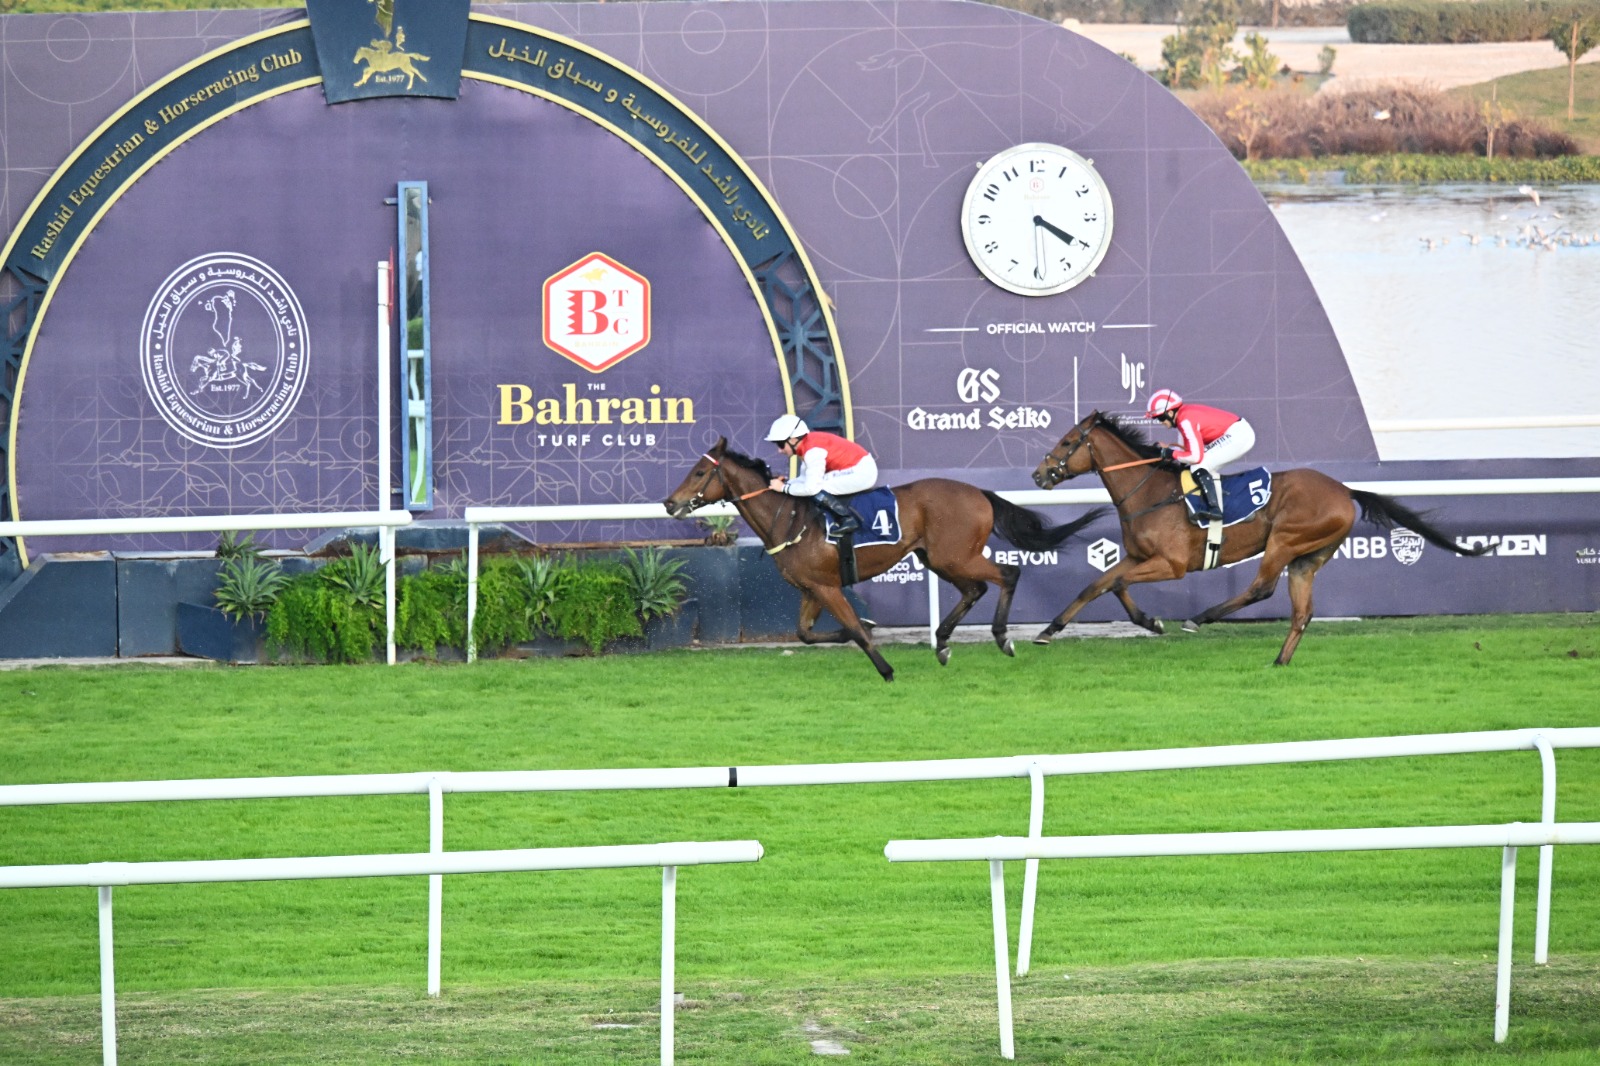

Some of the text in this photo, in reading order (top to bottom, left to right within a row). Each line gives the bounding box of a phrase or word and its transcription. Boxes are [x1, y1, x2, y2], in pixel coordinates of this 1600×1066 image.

[488, 37, 547, 68] الخيل
[547, 58, 603, 93] سباق
[621, 92, 707, 164] للفروسية
[30, 49, 302, 260] Rashid Equestrian & Horseracing Club
[1029, 159, 1045, 173] 12
[1058, 166, 1067, 178] 1
[701, 162, 740, 209] راشد
[983, 183, 1000, 202] 10
[1075, 184, 1089, 198] 2
[731, 203, 770, 241] نادي
[978, 214, 992, 225] 9
[1083, 211, 1097, 222] 3
[984, 240, 999, 254] 8
[1008, 258, 1019, 272] 7
[1059, 257, 1072, 272] 5
[986, 321, 1096, 335] OFFICIAL WATCH
[153, 352, 298, 436] Rashid Equestrian & Horseracing Club
[587, 383, 606, 391] THE
[957, 367, 1000, 404] GS
[496, 383, 696, 425] Bahrain
[907, 406, 1051, 431] Grand Seiko
[538, 434, 656, 447] TURF CLUB
[1249, 479, 1267, 506] 5
[871, 509, 893, 536] 4
[1332, 536, 1387, 559] NBB
[1455, 534, 1547, 557] HOWDEN
[995, 550, 1058, 566] BEYON
[871, 571, 924, 584] energies
